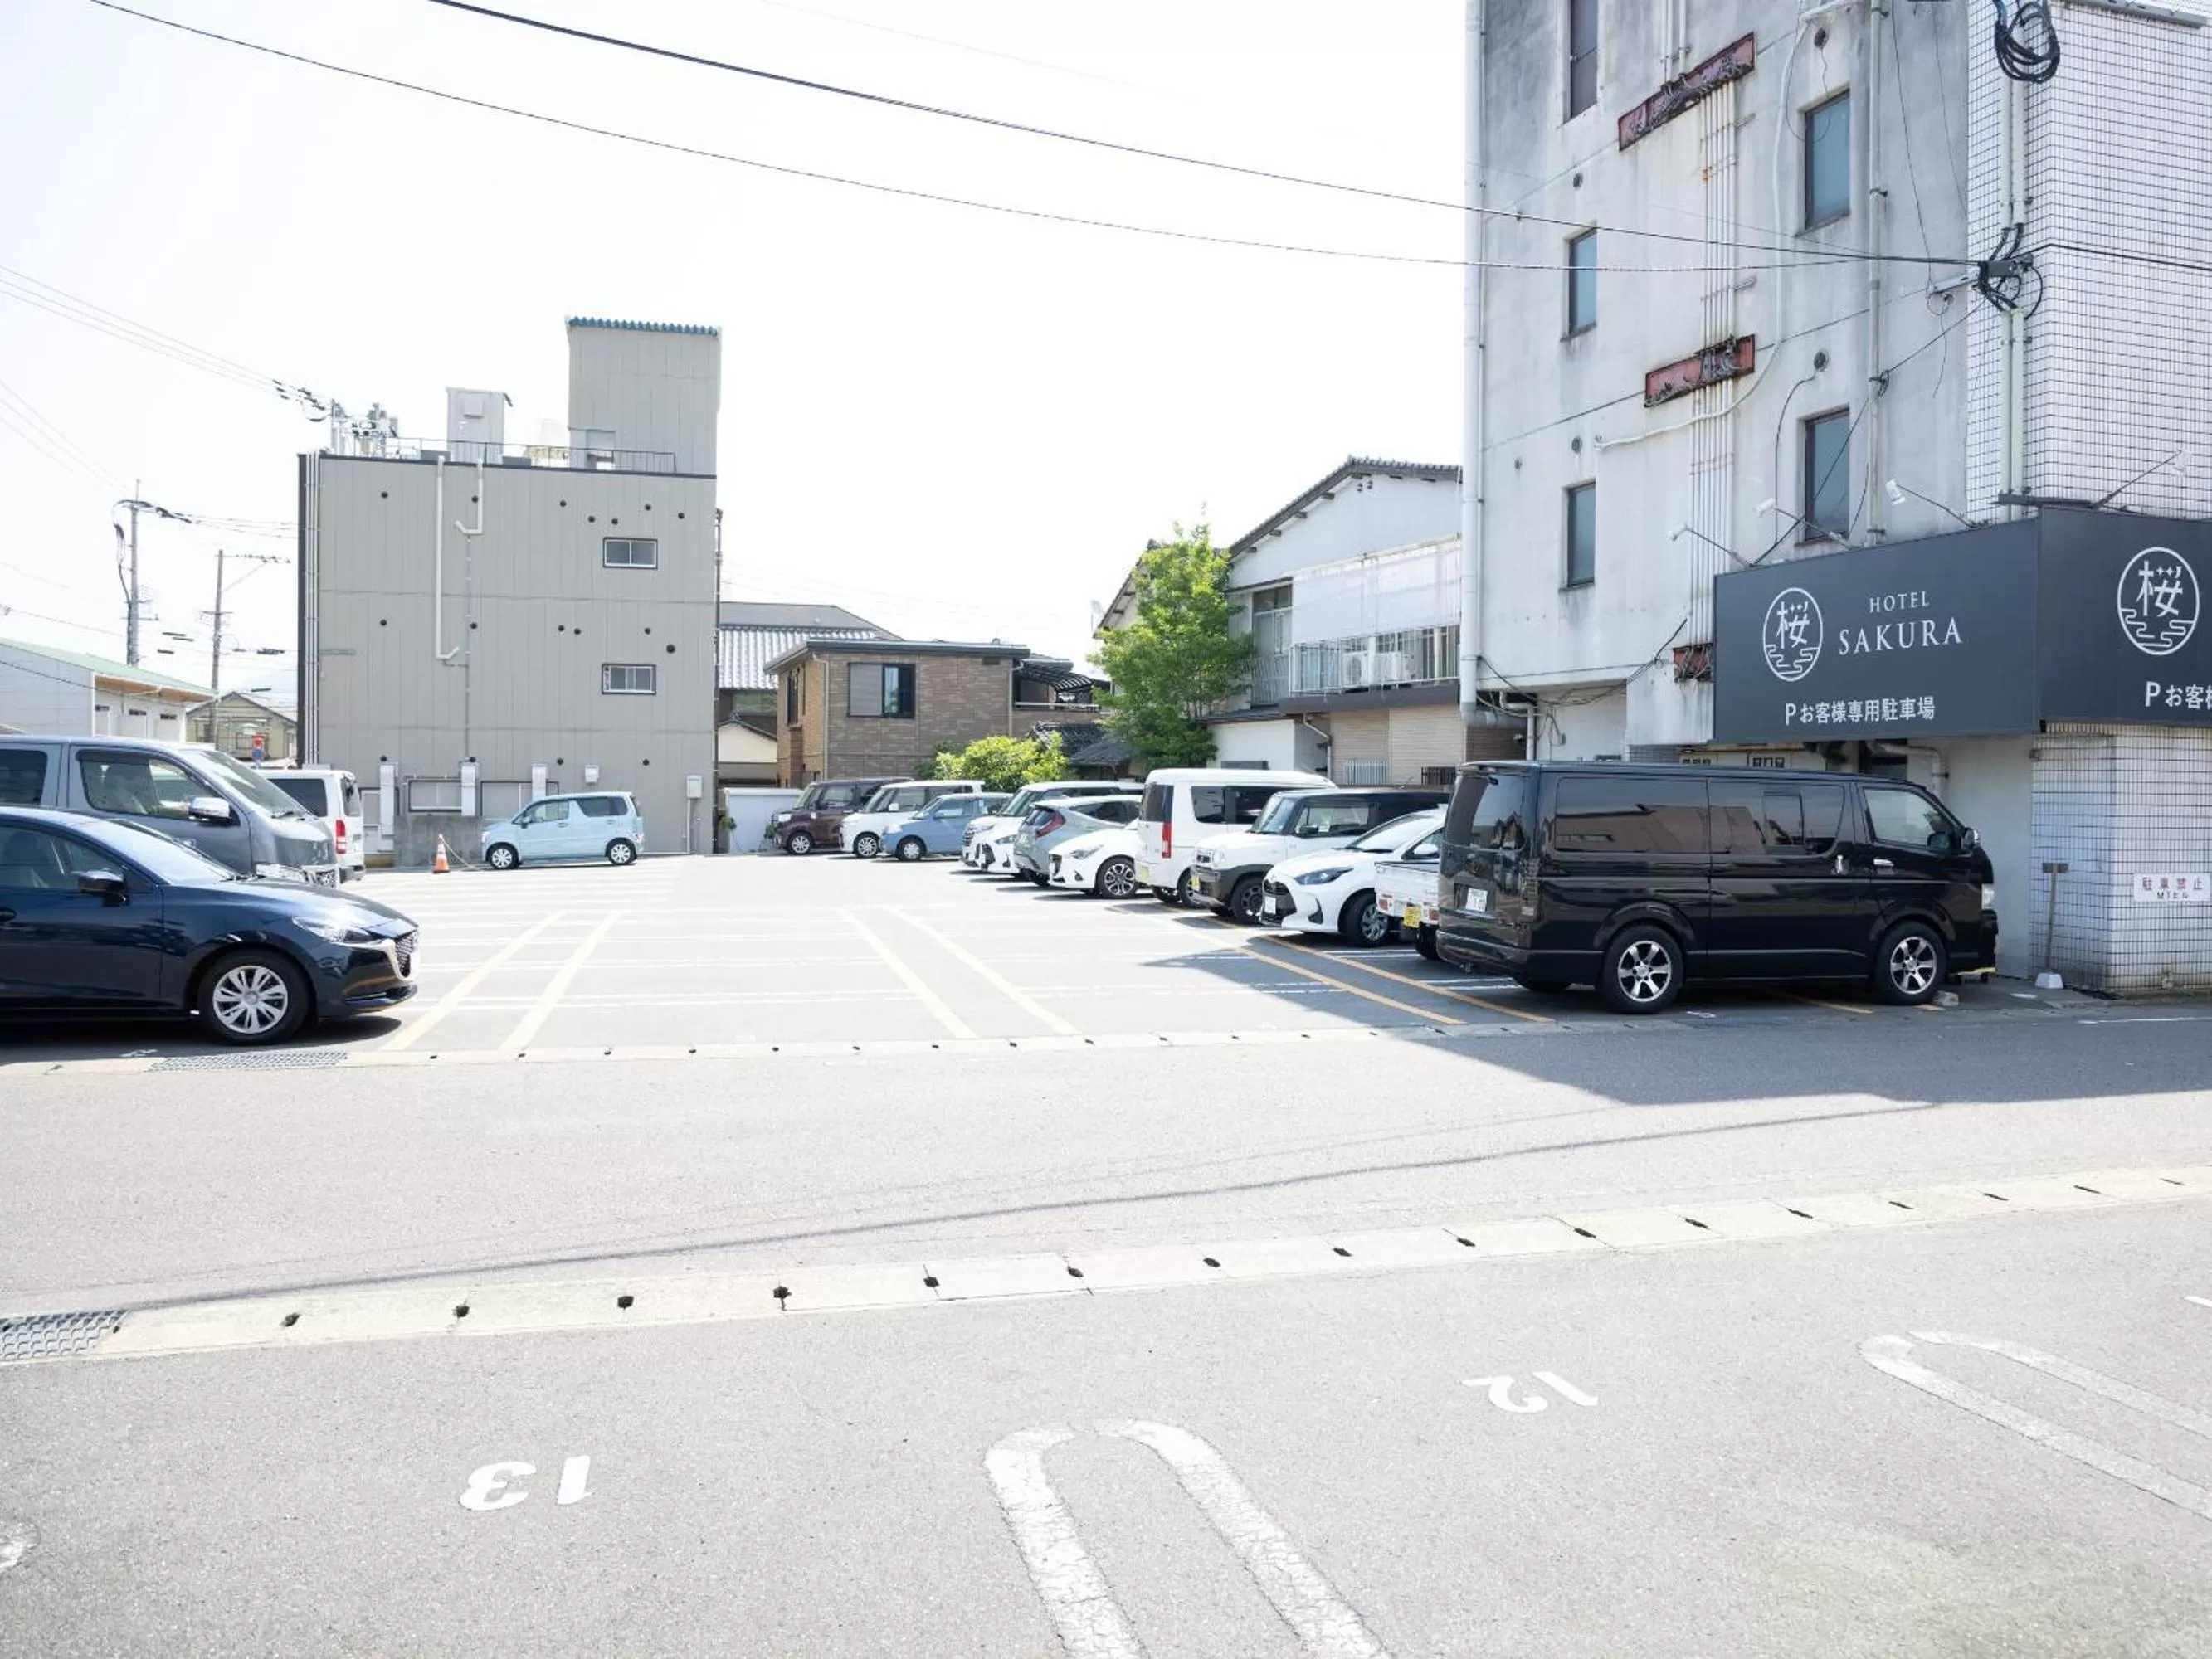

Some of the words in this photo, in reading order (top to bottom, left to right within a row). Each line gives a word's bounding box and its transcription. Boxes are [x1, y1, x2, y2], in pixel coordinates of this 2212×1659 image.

[1869, 591, 1930, 614] HOTEL
[2135, 560, 2183, 617] 桜
[1776, 601, 1810, 649] 桜
[1838, 616, 1964, 656] SAKURA
[1461, 1370, 1600, 1413] 12
[459, 1455, 592, 1511] 13
